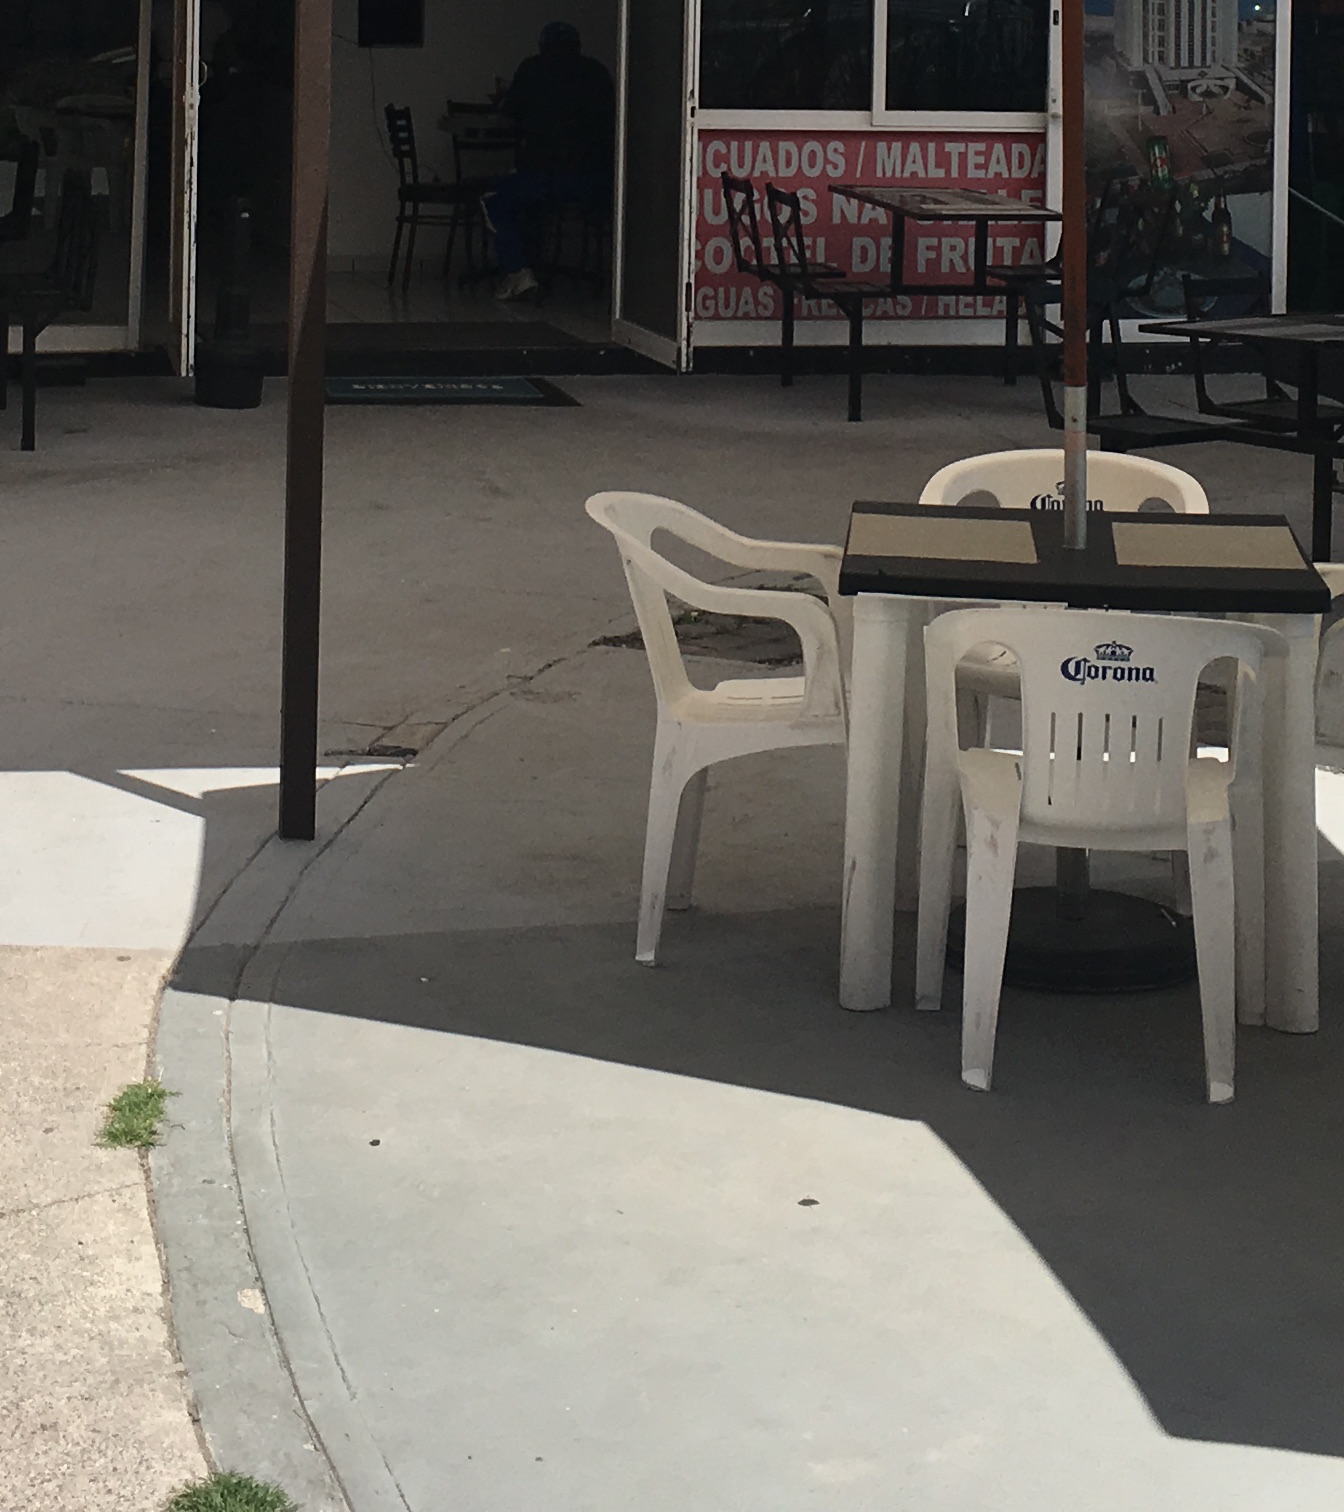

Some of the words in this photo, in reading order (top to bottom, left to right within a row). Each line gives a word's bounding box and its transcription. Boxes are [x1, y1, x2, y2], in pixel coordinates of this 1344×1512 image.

[697, 140, 846, 178] ICUADOS
[876, 142, 1045, 178] MALTEADA
[696, 285, 775, 317] GUAS
[1060, 656, 1155, 685] Corona
